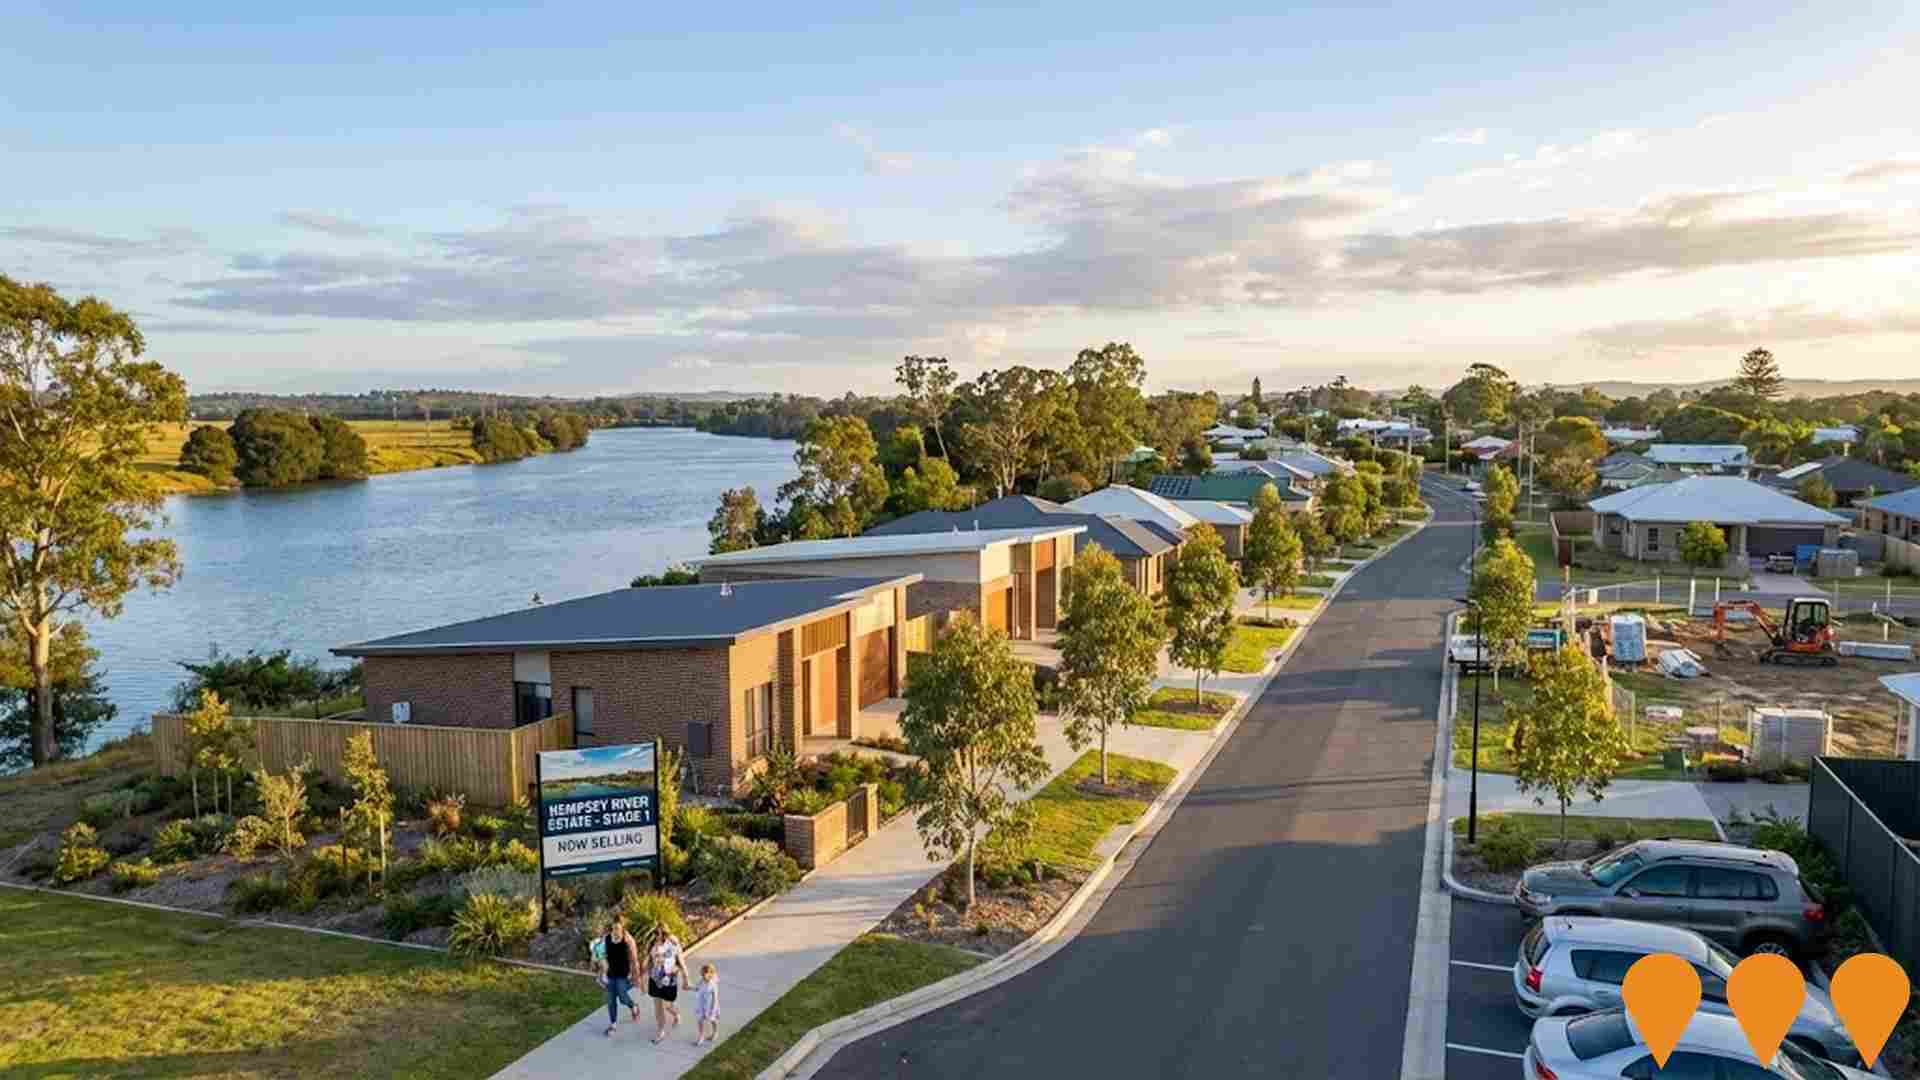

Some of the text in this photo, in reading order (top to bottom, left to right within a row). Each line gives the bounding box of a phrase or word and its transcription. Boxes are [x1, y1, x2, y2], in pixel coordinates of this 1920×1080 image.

[549, 796, 649, 816] HEMPSEY RIVER
[547, 815, 592, 831] ESTATE
[603, 810, 640, 826] STAGE
[645, 810, 650, 821] 1
[558, 832, 642, 852] NOW SELLING
